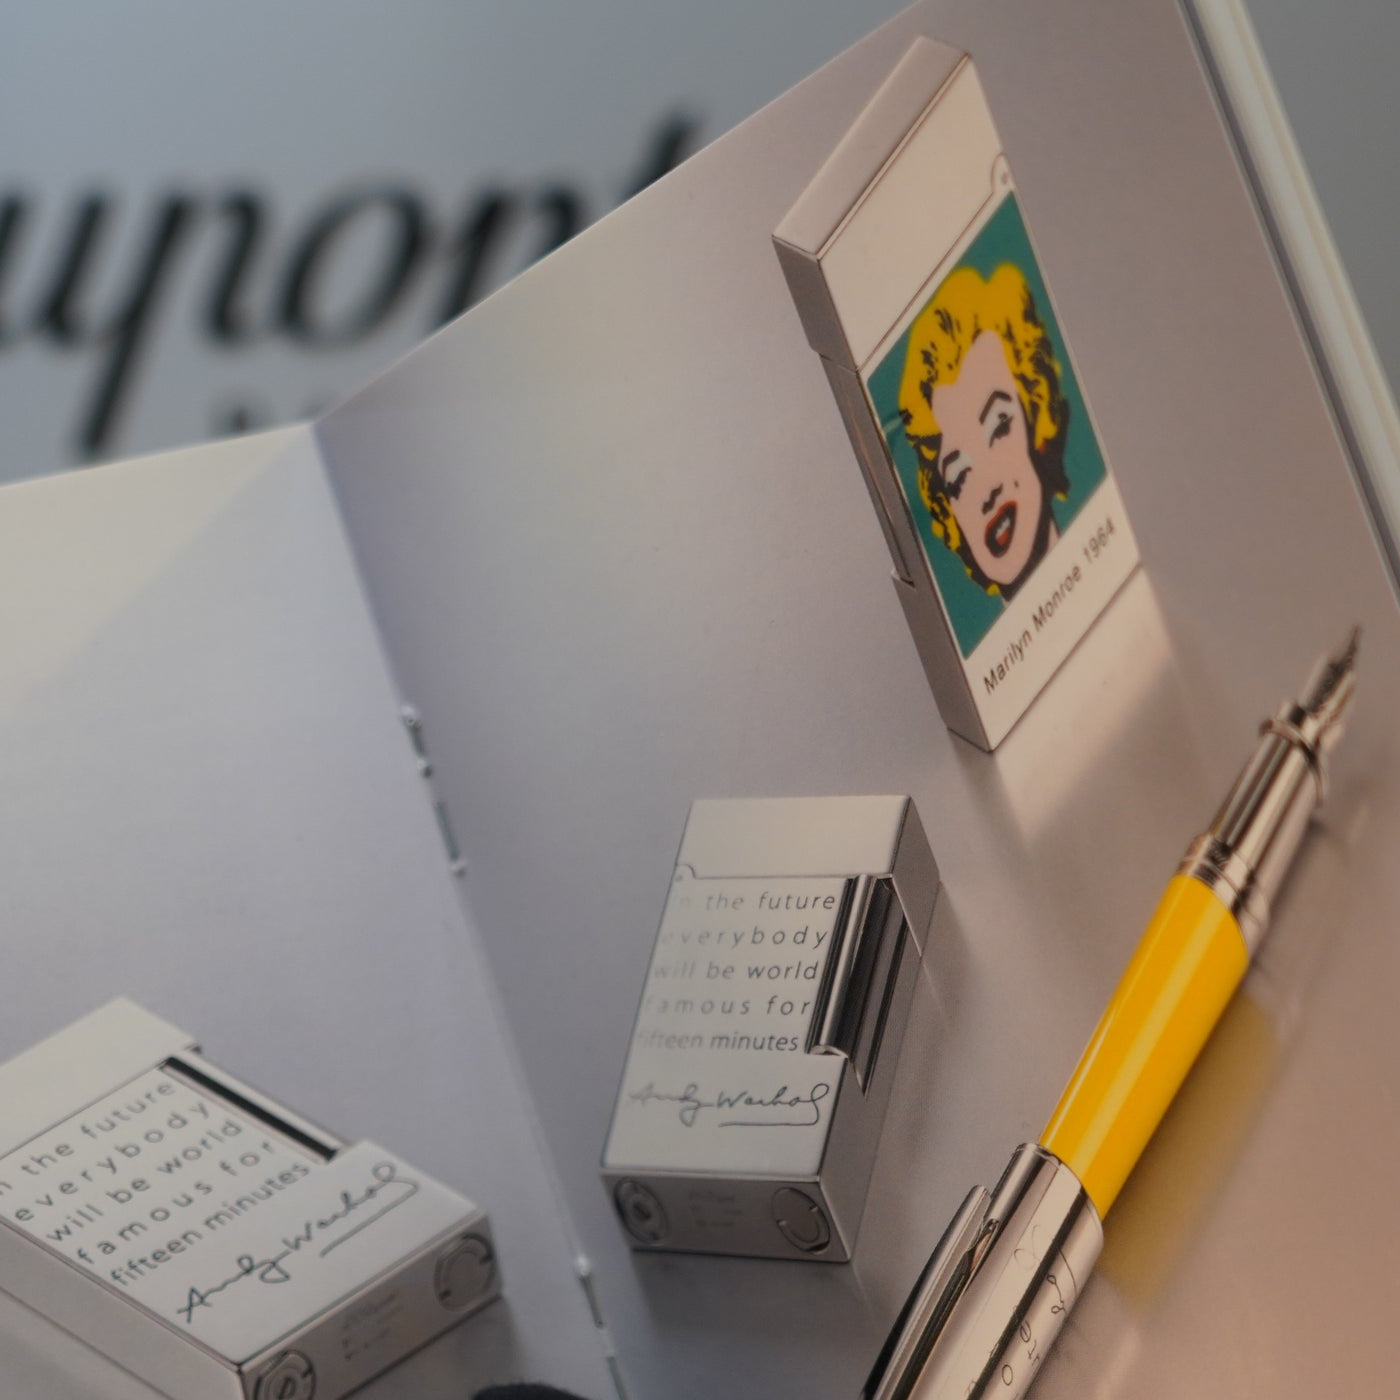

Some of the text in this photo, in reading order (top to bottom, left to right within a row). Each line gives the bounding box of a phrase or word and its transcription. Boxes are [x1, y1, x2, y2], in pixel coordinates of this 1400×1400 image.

[982, 514, 1116, 695] Marilyn Monroe 1964
[705, 892, 745, 911] the
[758, 890, 836, 911] future
[706, 960, 735, 980] be
[747, 960, 819, 981] world
[766, 994, 812, 1016] for
[710, 1031, 799, 1051] minutes
[14, 1101, 211, 1223] everybody
[21, 1142, 75, 1176] the
[79, 1081, 176, 1140] future
[45, 1119, 243, 1243] will be world
[76, 1140, 277, 1266] famous for
[109, 1162, 311, 1286] fifteen minutes
